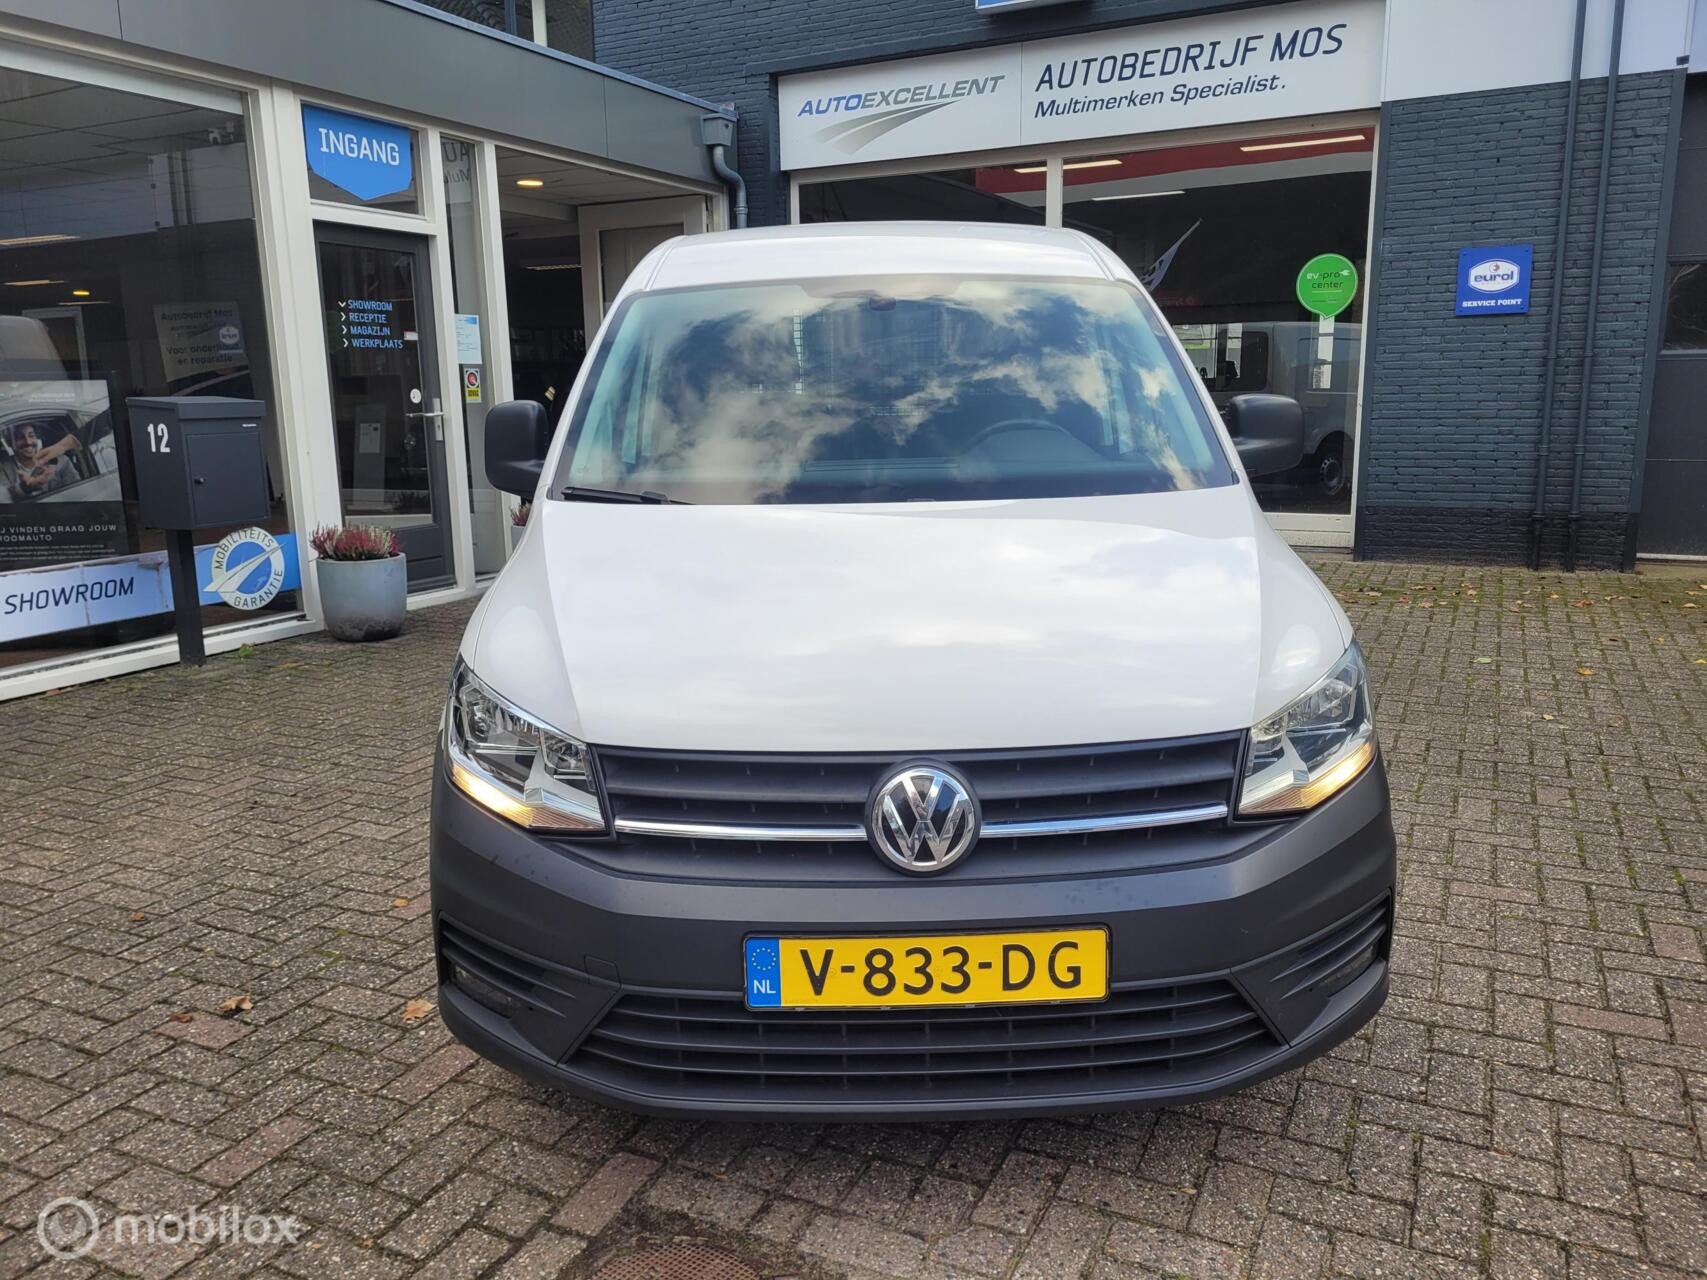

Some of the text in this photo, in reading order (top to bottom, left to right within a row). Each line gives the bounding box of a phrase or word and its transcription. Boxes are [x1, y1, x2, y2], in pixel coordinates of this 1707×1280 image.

[1035, 23, 1348, 92] AUTOBEDRIJF MOS
[797, 75, 1005, 117] AUTOEXCELLENT
[1034, 74, 1286, 118] Multimerken Specialist.
[318, 127, 400, 166] INGANG
[1306, 271, 1341, 281] ev-pro
[1474, 270, 1514, 283] eurol
[1311, 281, 1344, 289] center
[347, 299, 393, 311] SHOWROOM
[1462, 298, 1522, 308] SERVICE POINT
[349, 312, 388, 323] RECEPTIE
[350, 325, 391, 336] MAGAZIJN
[351, 338, 404, 349] WERKPLAATS
[147, 423, 171, 453] 12
[9, 525, 46, 534] VINDEN
[49, 525, 85, 533] GRAAG
[88, 524, 117, 532] JOUW
[214, 528, 274, 569] MOBILITEITS
[4, 577, 135, 615] SHOWROOM
[233, 569, 283, 608] GARANTIE
[799, 941, 1082, 997] V-833-DG
[753, 979, 777, 994] NL
